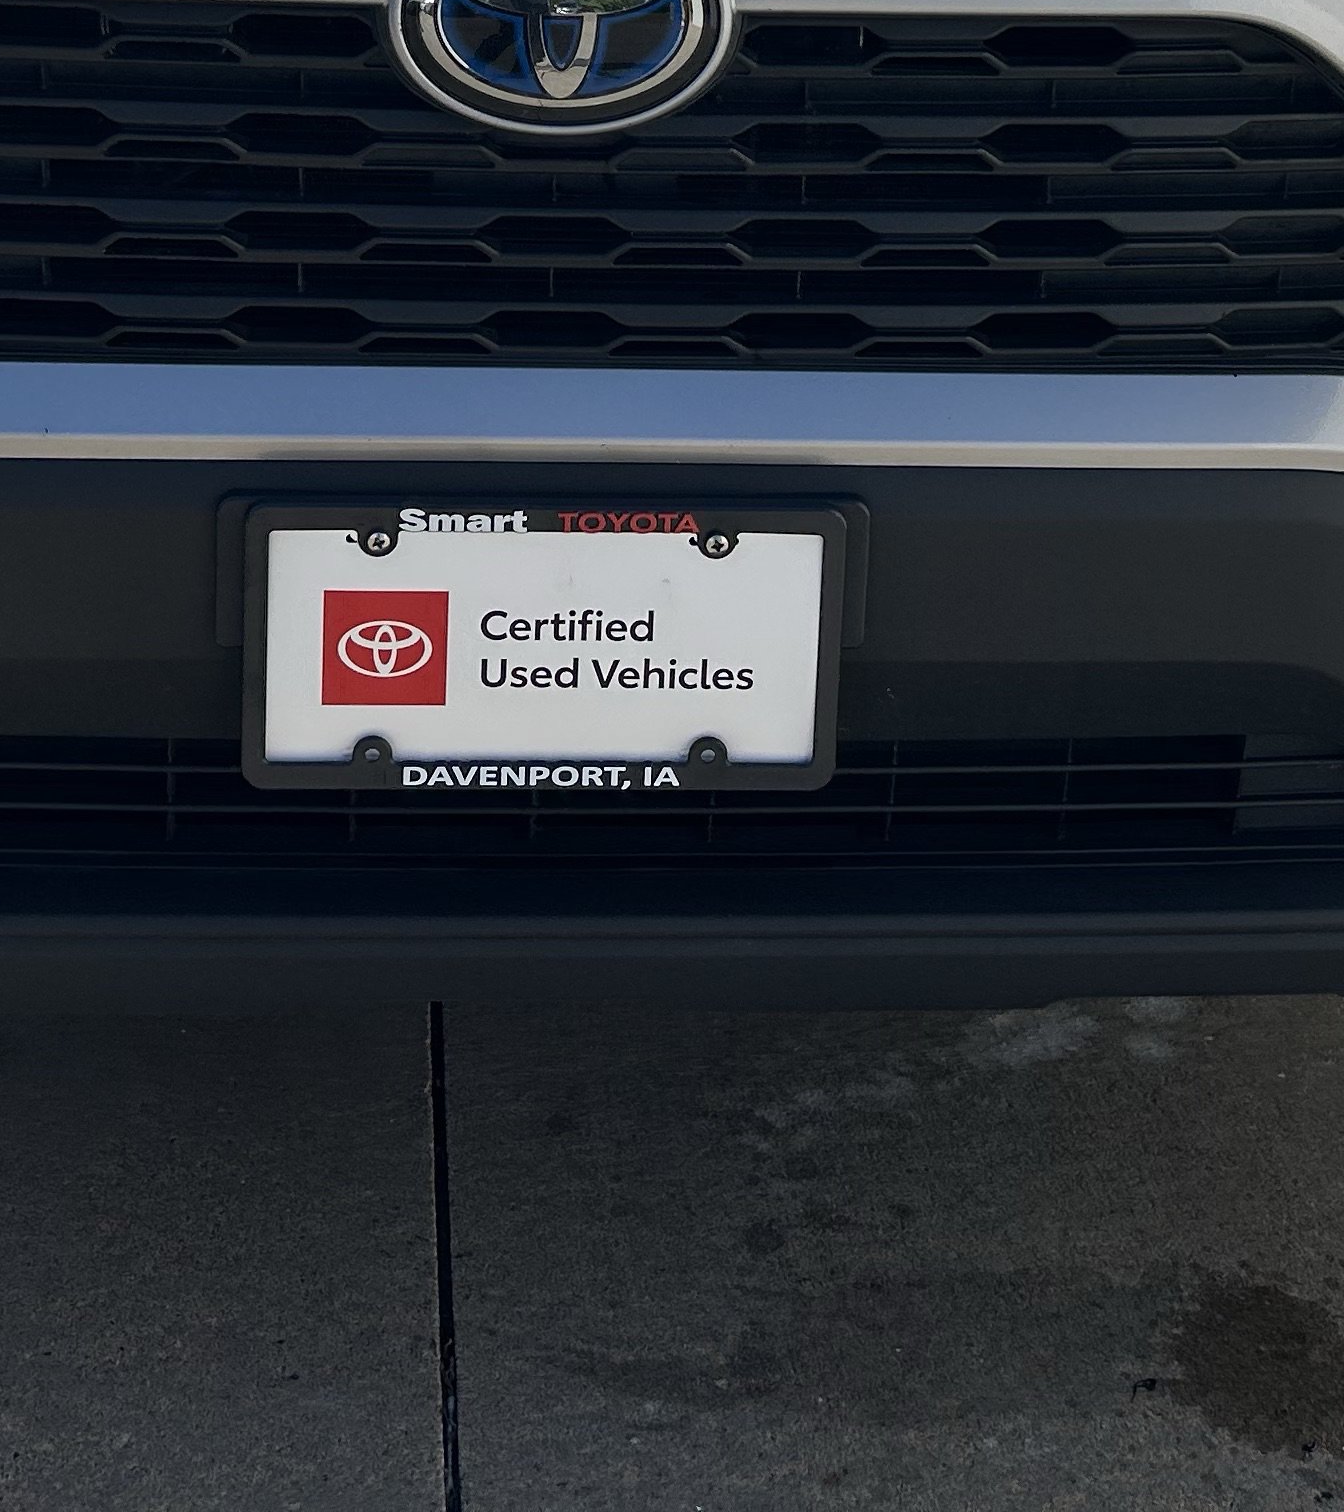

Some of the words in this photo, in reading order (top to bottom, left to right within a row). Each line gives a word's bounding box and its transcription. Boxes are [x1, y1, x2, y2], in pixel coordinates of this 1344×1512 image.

[398, 507, 528, 534] Smart
[558, 511, 699, 534] TOYOTA
[480, 610, 655, 643] Certified
[480, 657, 579, 689] Used
[592, 659, 754, 691] Vehicles
[402, 766, 631, 791] DAVENPORT,
[643, 767, 680, 787] IA
